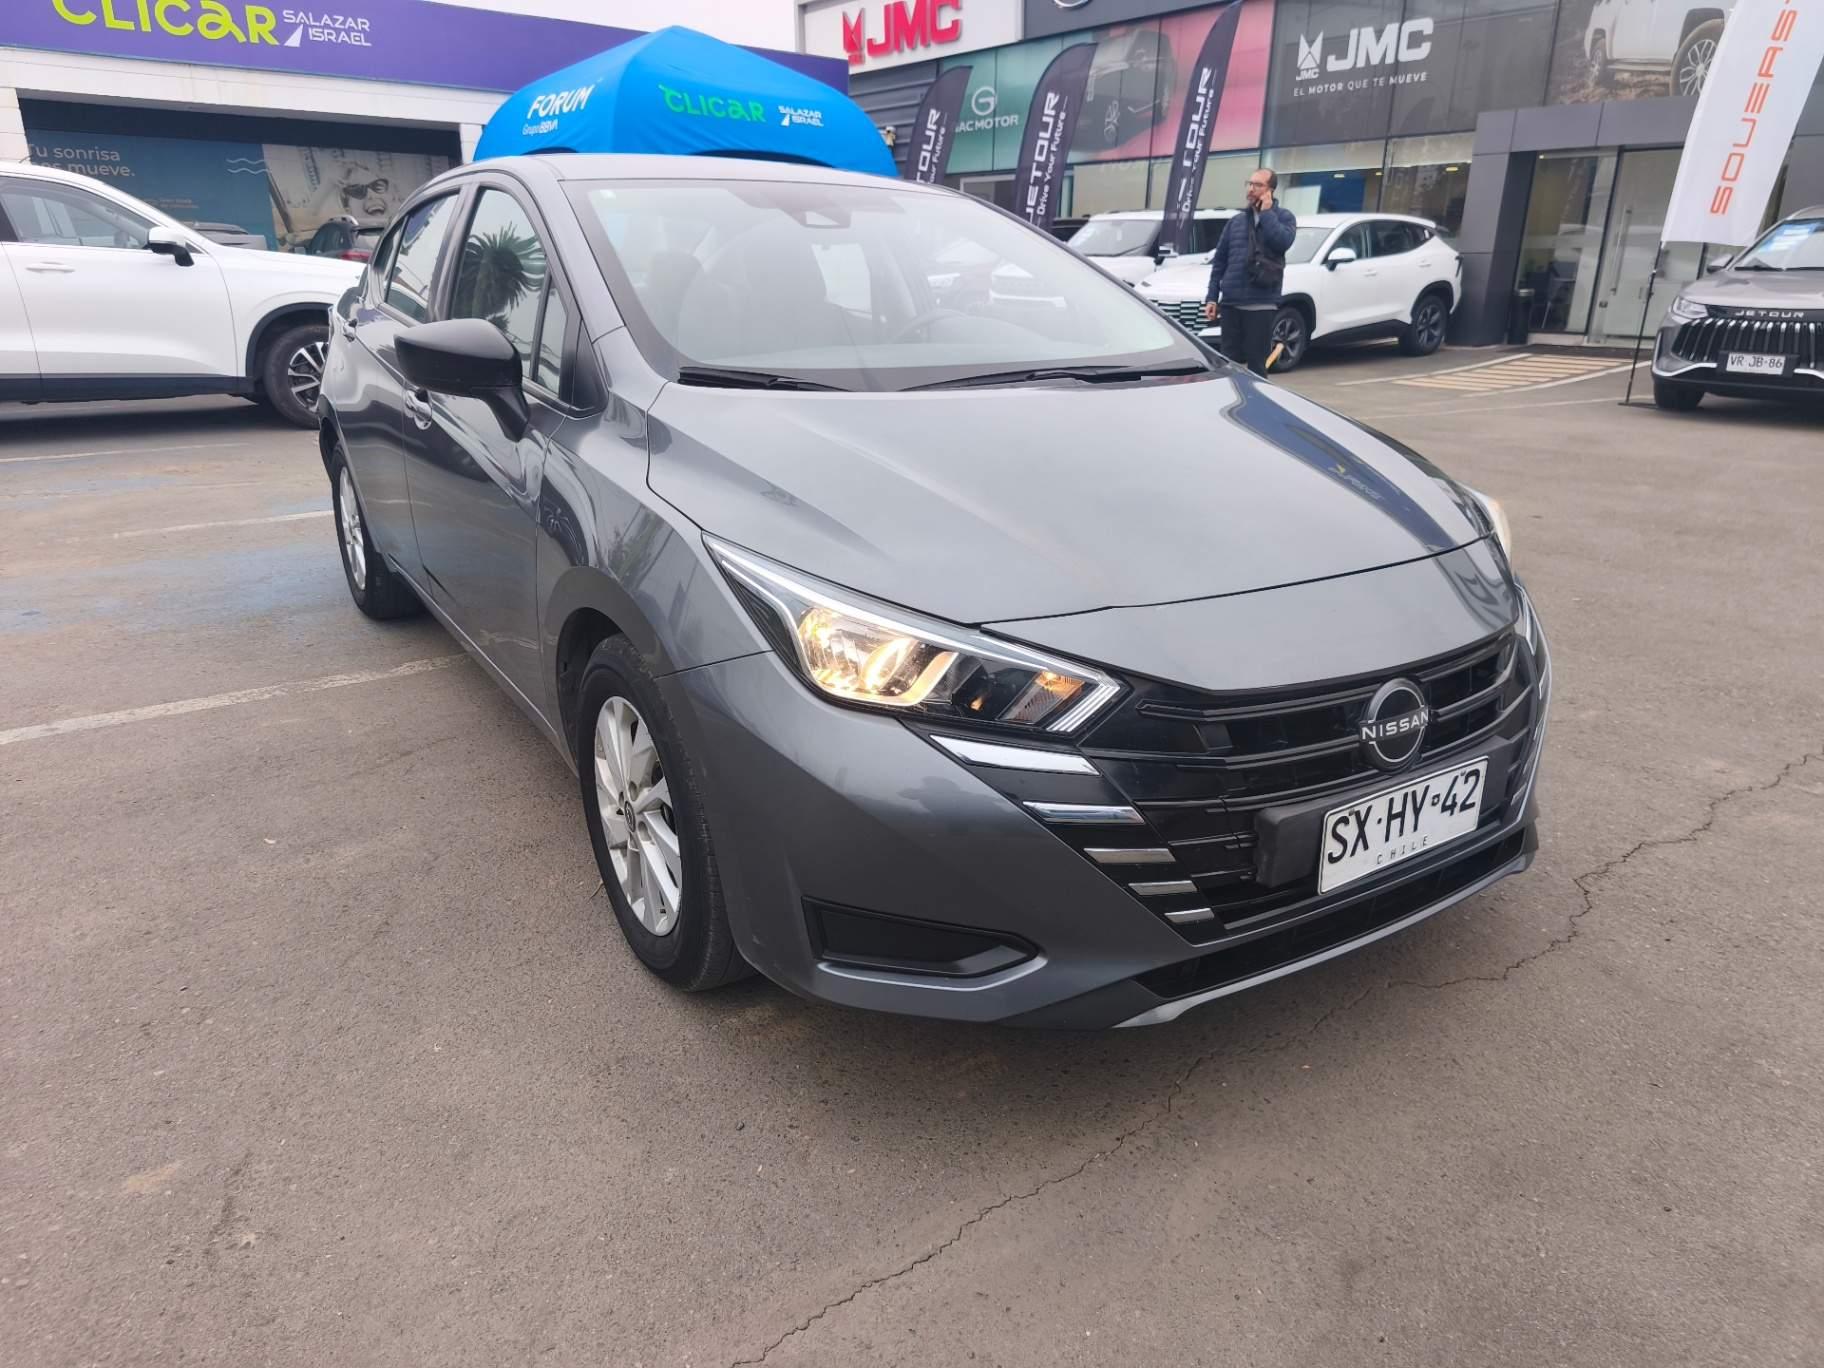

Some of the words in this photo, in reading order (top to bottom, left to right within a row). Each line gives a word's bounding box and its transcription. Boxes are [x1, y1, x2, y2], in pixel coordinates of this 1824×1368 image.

[283, 10, 370, 32] SALAZAR
[867, 0, 961, 57] JMC
[309, 28, 372, 46] ISRAEL
[1325, 17, 1434, 72] JMC
[1293, 88, 1305, 97] EL
[1308, 82, 1343, 95] MOTOR
[1347, 79, 1369, 91] QUE
[1373, 77, 1385, 87] TE
[1389, 72, 1428, 86] MUEVE
[1296, 69, 1319, 81] JMC
[527, 84, 596, 120] FORUM
[777, 105, 823, 118] SALAZAR
[1198, 88, 1215, 137] Future
[1710, 0, 1798, 215] SOUEAS
[791, 115, 824, 127] ISRAEL
[975, 115, 1019, 131] MOTOR
[1050, 111, 1066, 152] Future
[53, 146, 121, 162] sonrisa
[931, 126, 946, 163] Future
[1026, 92, 1061, 224] JETOUR
[67, 162, 136, 177] mueve.
[928, 165, 938, 184] our
[1044, 153, 1057, 182] Your
[1036, 184, 1050, 216] Drive
[1361, 711, 1430, 740] NISSAN
[1376, 835, 1429, 865] CHILE
